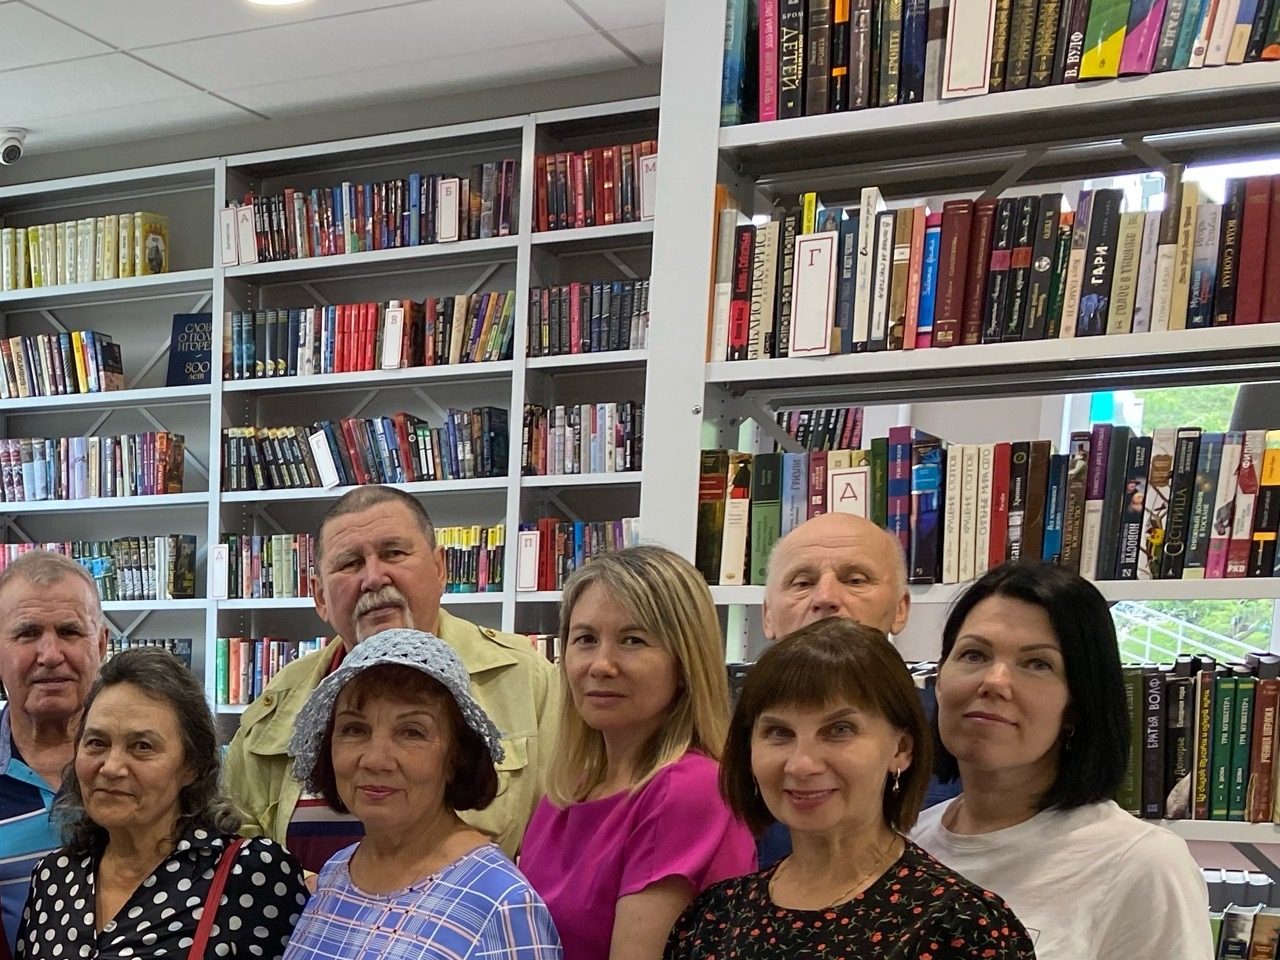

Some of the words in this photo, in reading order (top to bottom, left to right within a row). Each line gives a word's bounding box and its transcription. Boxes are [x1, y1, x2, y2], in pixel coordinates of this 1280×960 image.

[781, 27, 799, 91] ДЕТЕЙ
[1068, 31, 1083, 63] ВУЛФ
[1065, 66, 1078, 78] В.
[1225, 219, 1237, 245] ВОДЫ
[808, 248, 822, 267] Г
[1091, 245, 1108, 285] ГАРИ
[1221, 248, 1233, 288] СЛОНАМ
[1067, 280, 1079, 318] ГАМСУН
[1116, 284, 1128, 315] ГОЛОС
[179, 333, 187, 342] О
[190, 333, 212, 342] ПОЛ
[185, 323, 212, 332] СЛОВ
[177, 342, 212, 352] ИГОРЕ
[185, 361, 210, 373] 800
[983, 448, 991, 469] СЕГО
[839, 482, 858, 503] Д
[981, 472, 990, 494] МИРА
[948, 495, 956, 534] КРУШЕНИЕ
[963, 495, 972, 534] КРУШЕНИЕ
[979, 497, 988, 535] СИЛЬНЫЕ
[1164, 487, 1187, 556] СЕСТРИЦА
[1126, 523, 1139, 563] НОВОСТИ
[1148, 678, 1161, 710] ВОЛФ
[1147, 716, 1159, 748] БРАТЬЯ
